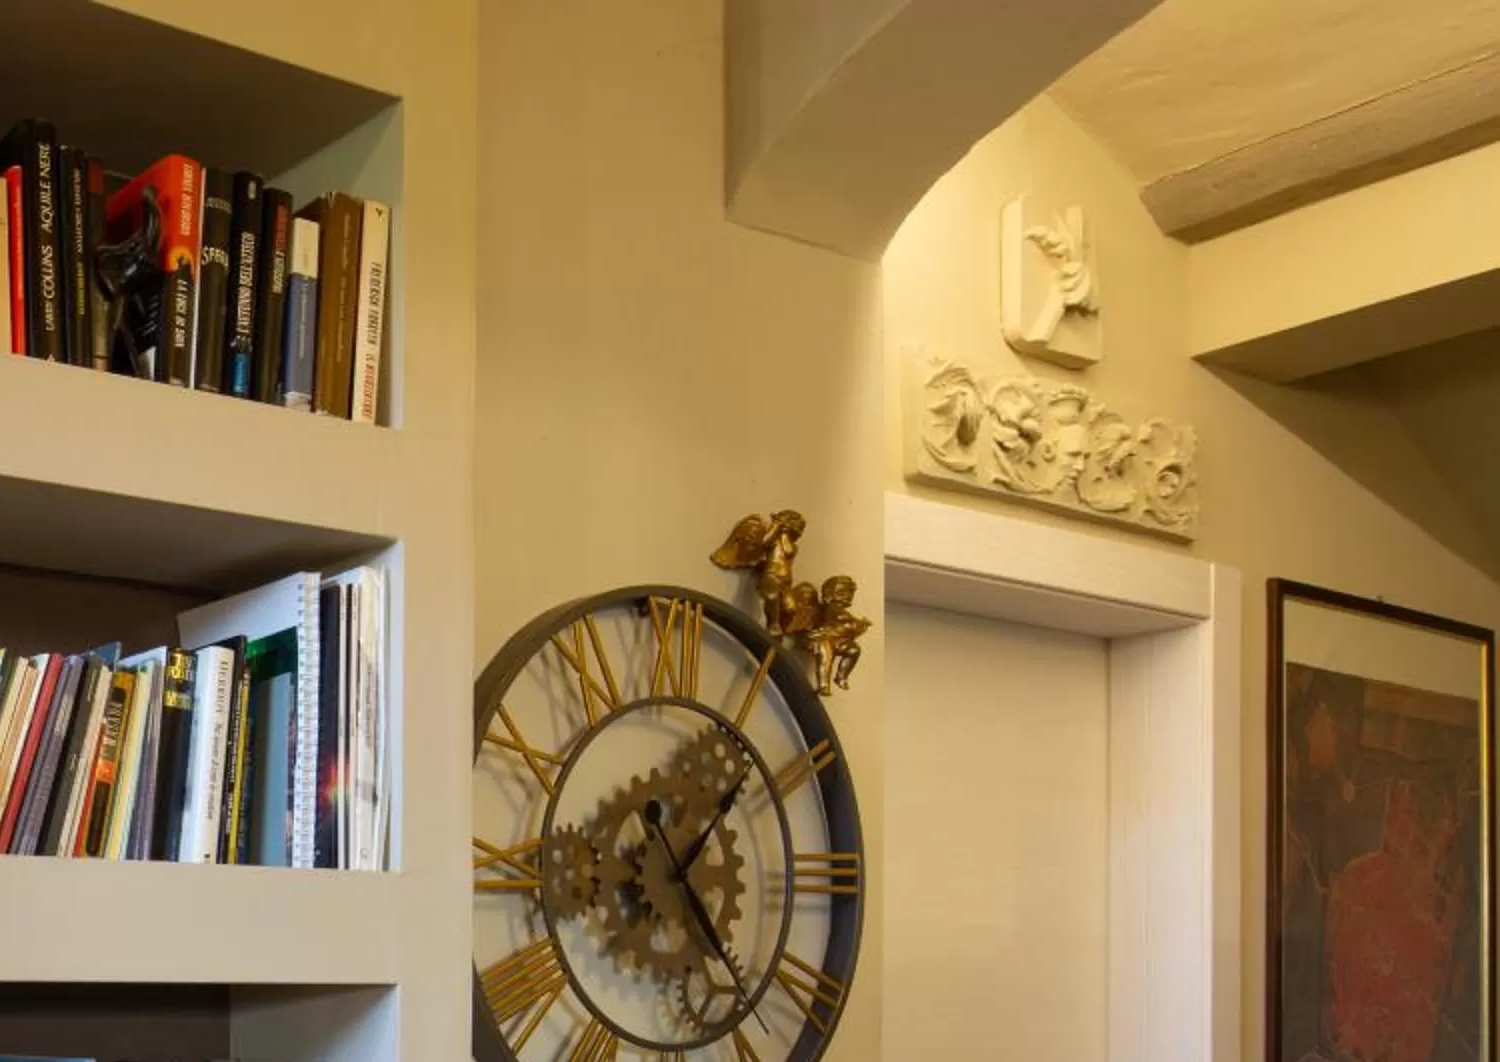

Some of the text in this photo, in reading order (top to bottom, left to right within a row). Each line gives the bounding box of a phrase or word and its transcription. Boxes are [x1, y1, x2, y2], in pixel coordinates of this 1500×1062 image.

[38, 143, 52, 178] NERE
[38, 181, 53, 237] AQUILE
[41, 244, 55, 298] COLLINS
